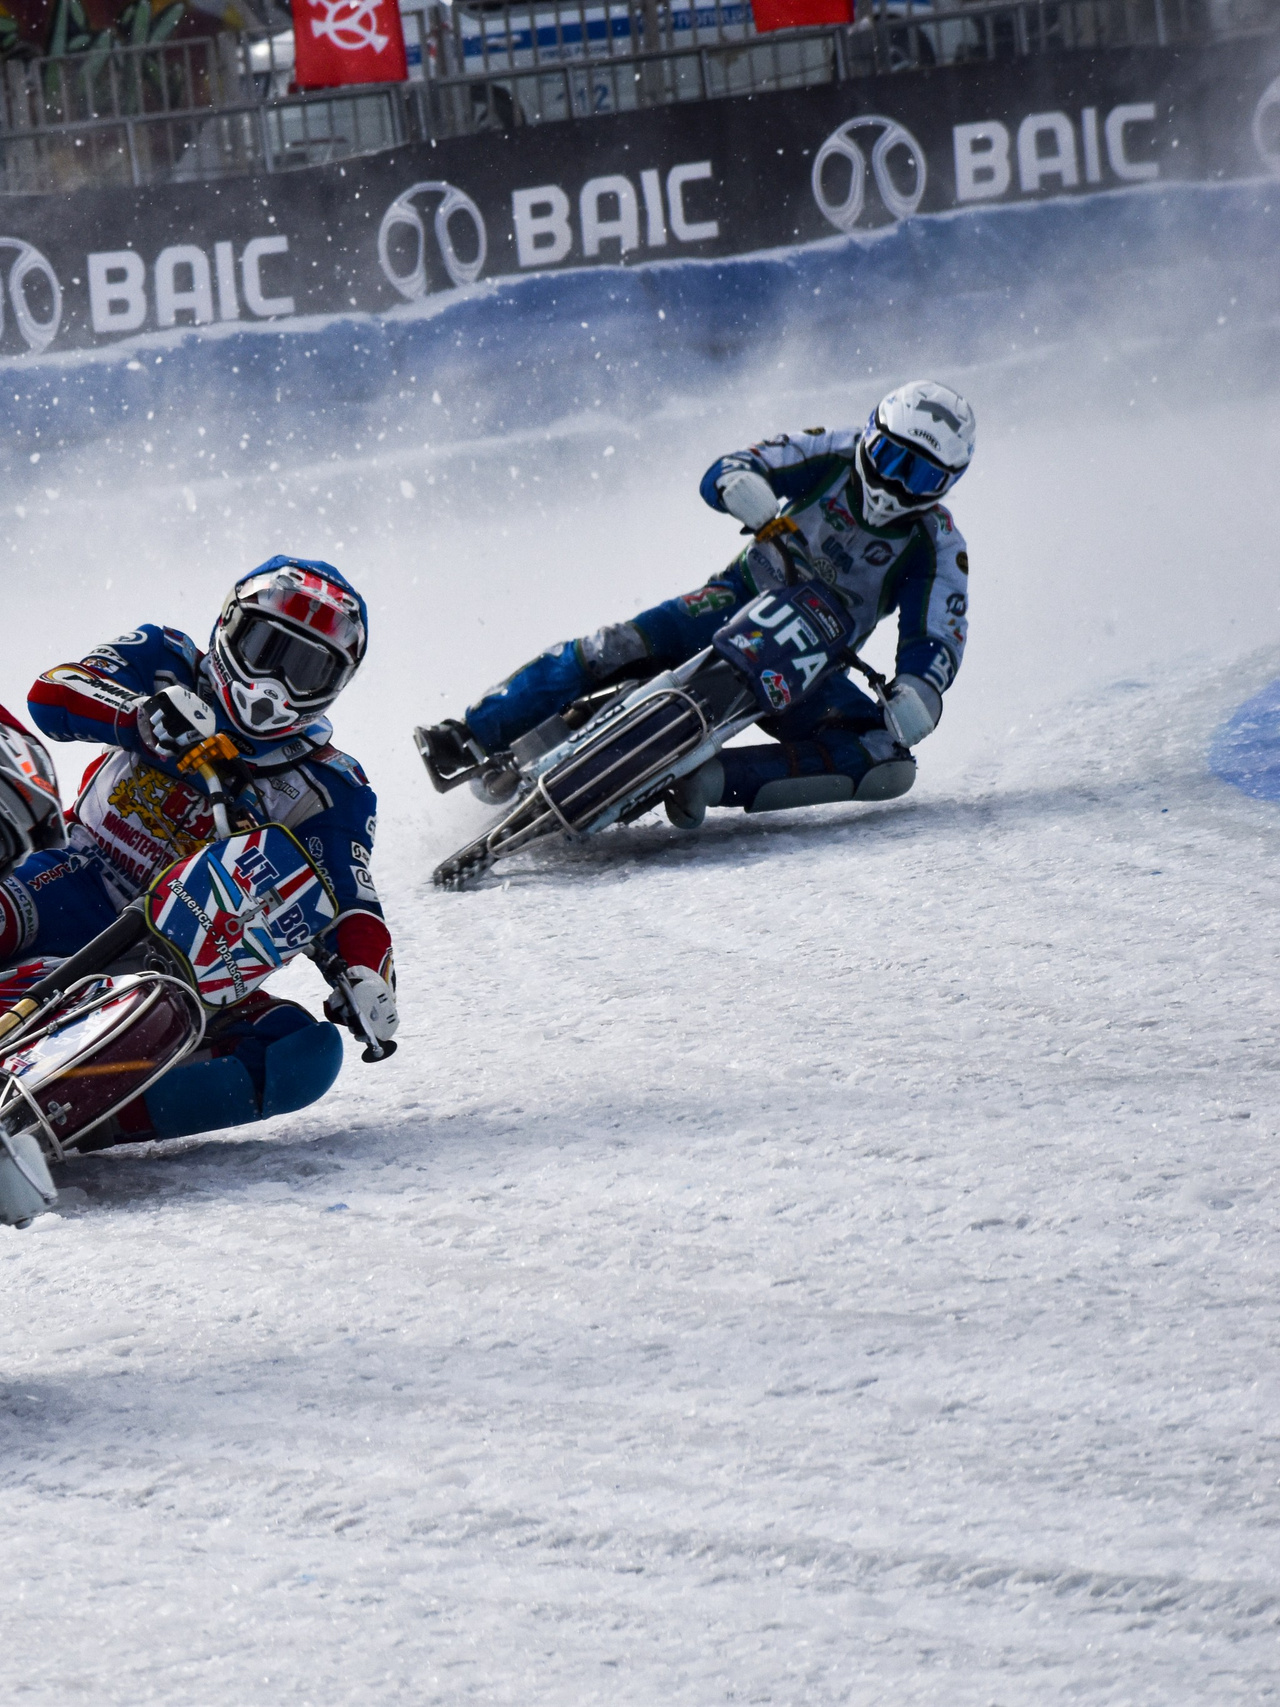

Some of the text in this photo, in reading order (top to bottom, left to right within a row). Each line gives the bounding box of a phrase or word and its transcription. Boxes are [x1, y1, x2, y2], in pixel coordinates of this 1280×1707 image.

[953, 103, 1159, 200] BAIC
[512, 162, 718, 267] BAIC
[88, 236, 295, 333] BAIC
[747, 595, 828, 691] UFA
[102, 811, 175, 871] МИНИСТЕРСТВ
